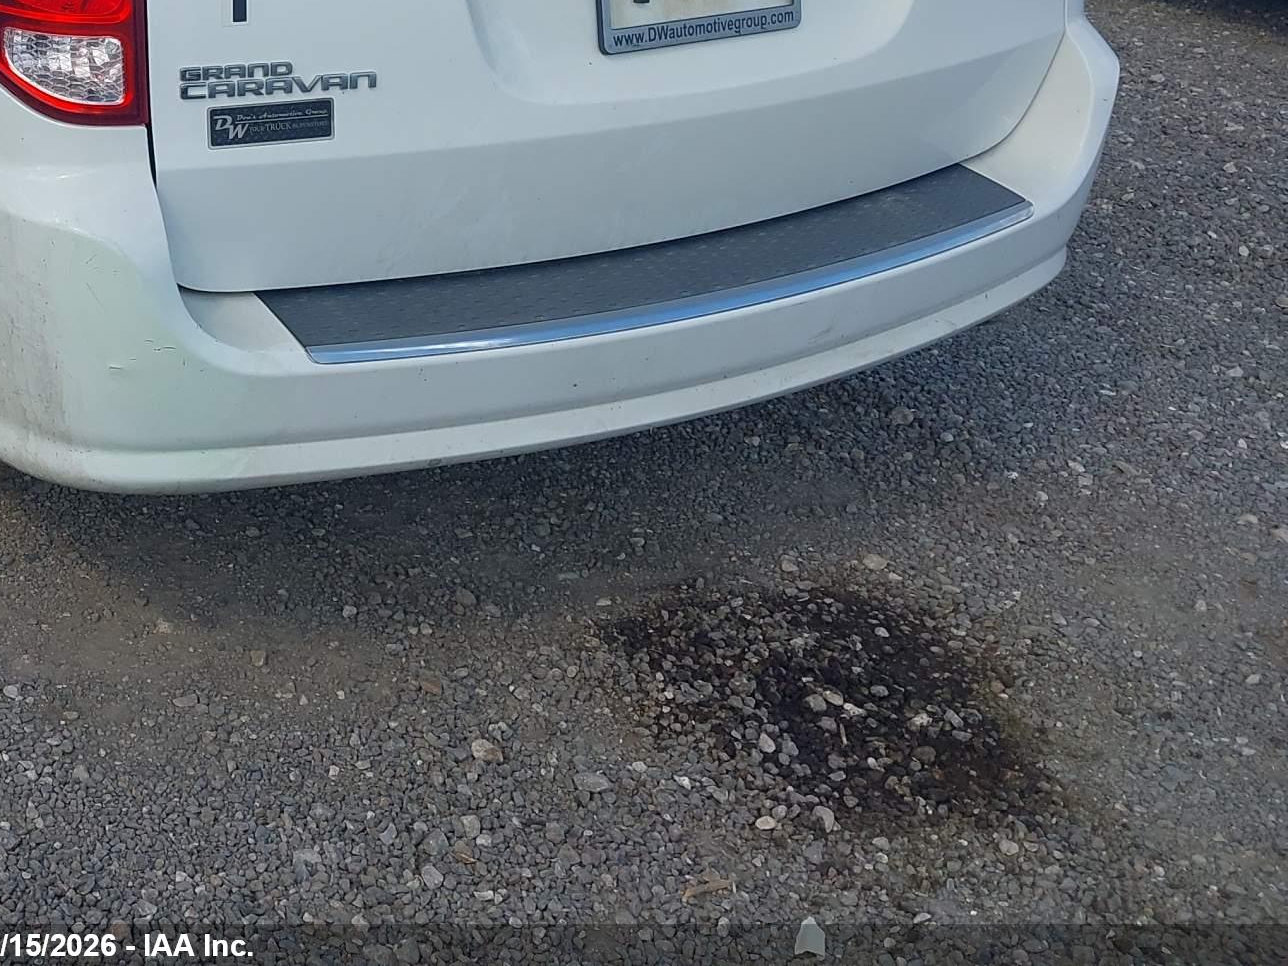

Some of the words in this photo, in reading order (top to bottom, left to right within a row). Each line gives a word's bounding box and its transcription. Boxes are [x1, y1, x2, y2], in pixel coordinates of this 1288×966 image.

[612, 8, 795, 48] www.DWautomotivegroup.com
[179, 60, 293, 82] GRAND
[179, 71, 378, 100] CARAVAN
[213, 114, 249, 140] DW
[266, 121, 292, 132] TRUCK
